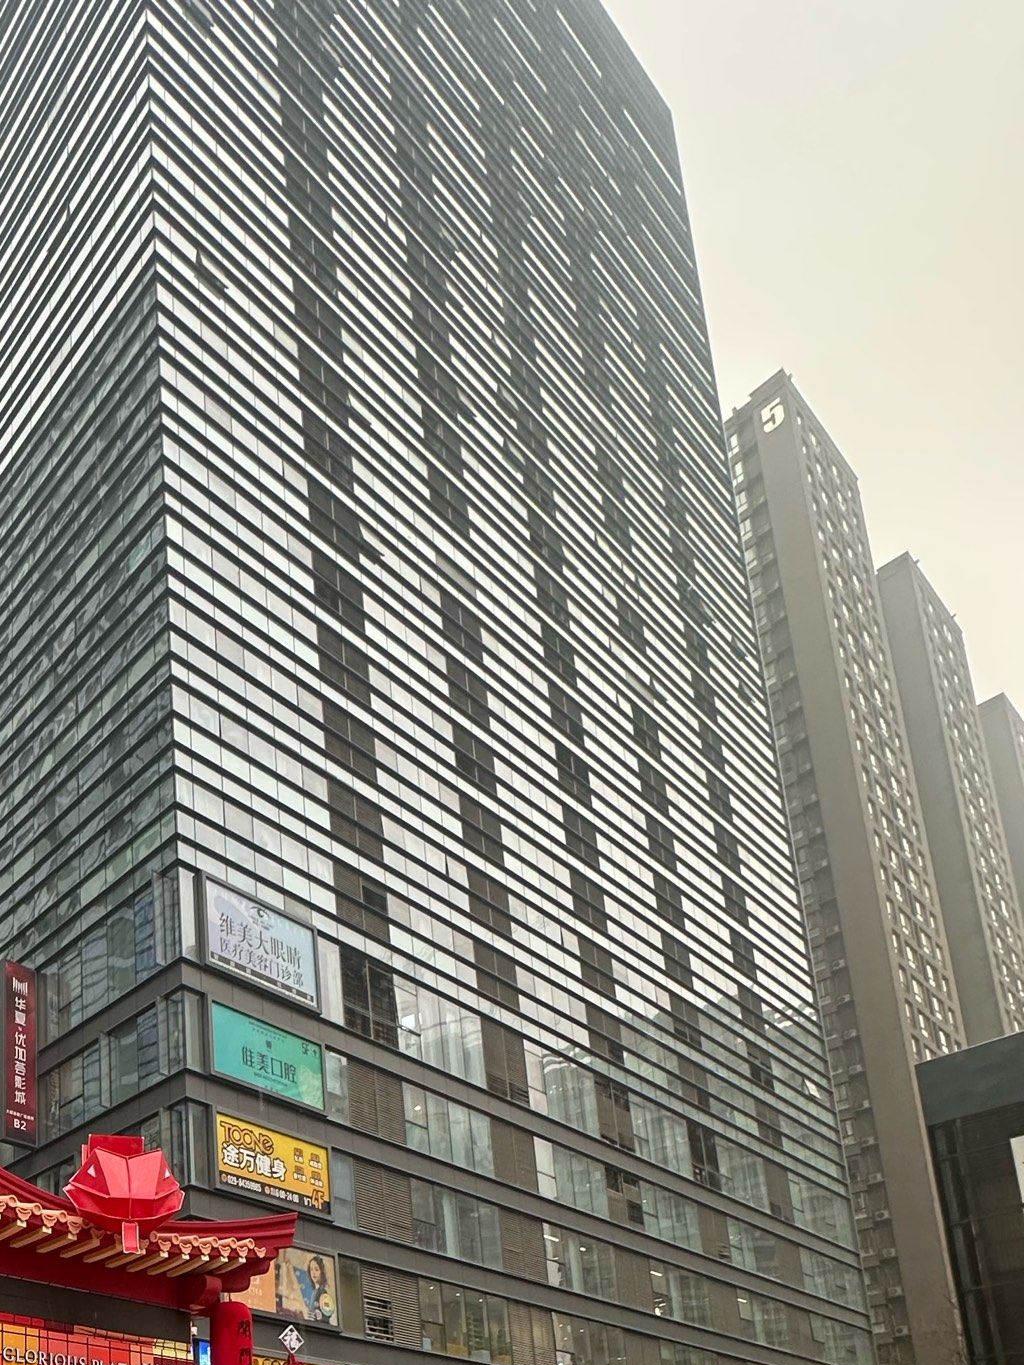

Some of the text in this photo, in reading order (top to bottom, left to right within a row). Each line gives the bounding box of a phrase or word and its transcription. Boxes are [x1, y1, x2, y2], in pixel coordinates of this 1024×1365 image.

[761, 397, 784, 433] 5
[219, 911, 302, 970] 维美大眼睛
[220, 936, 304, 988] 医疗美容门诊部
[13, 1118, 27, 1131] B2
